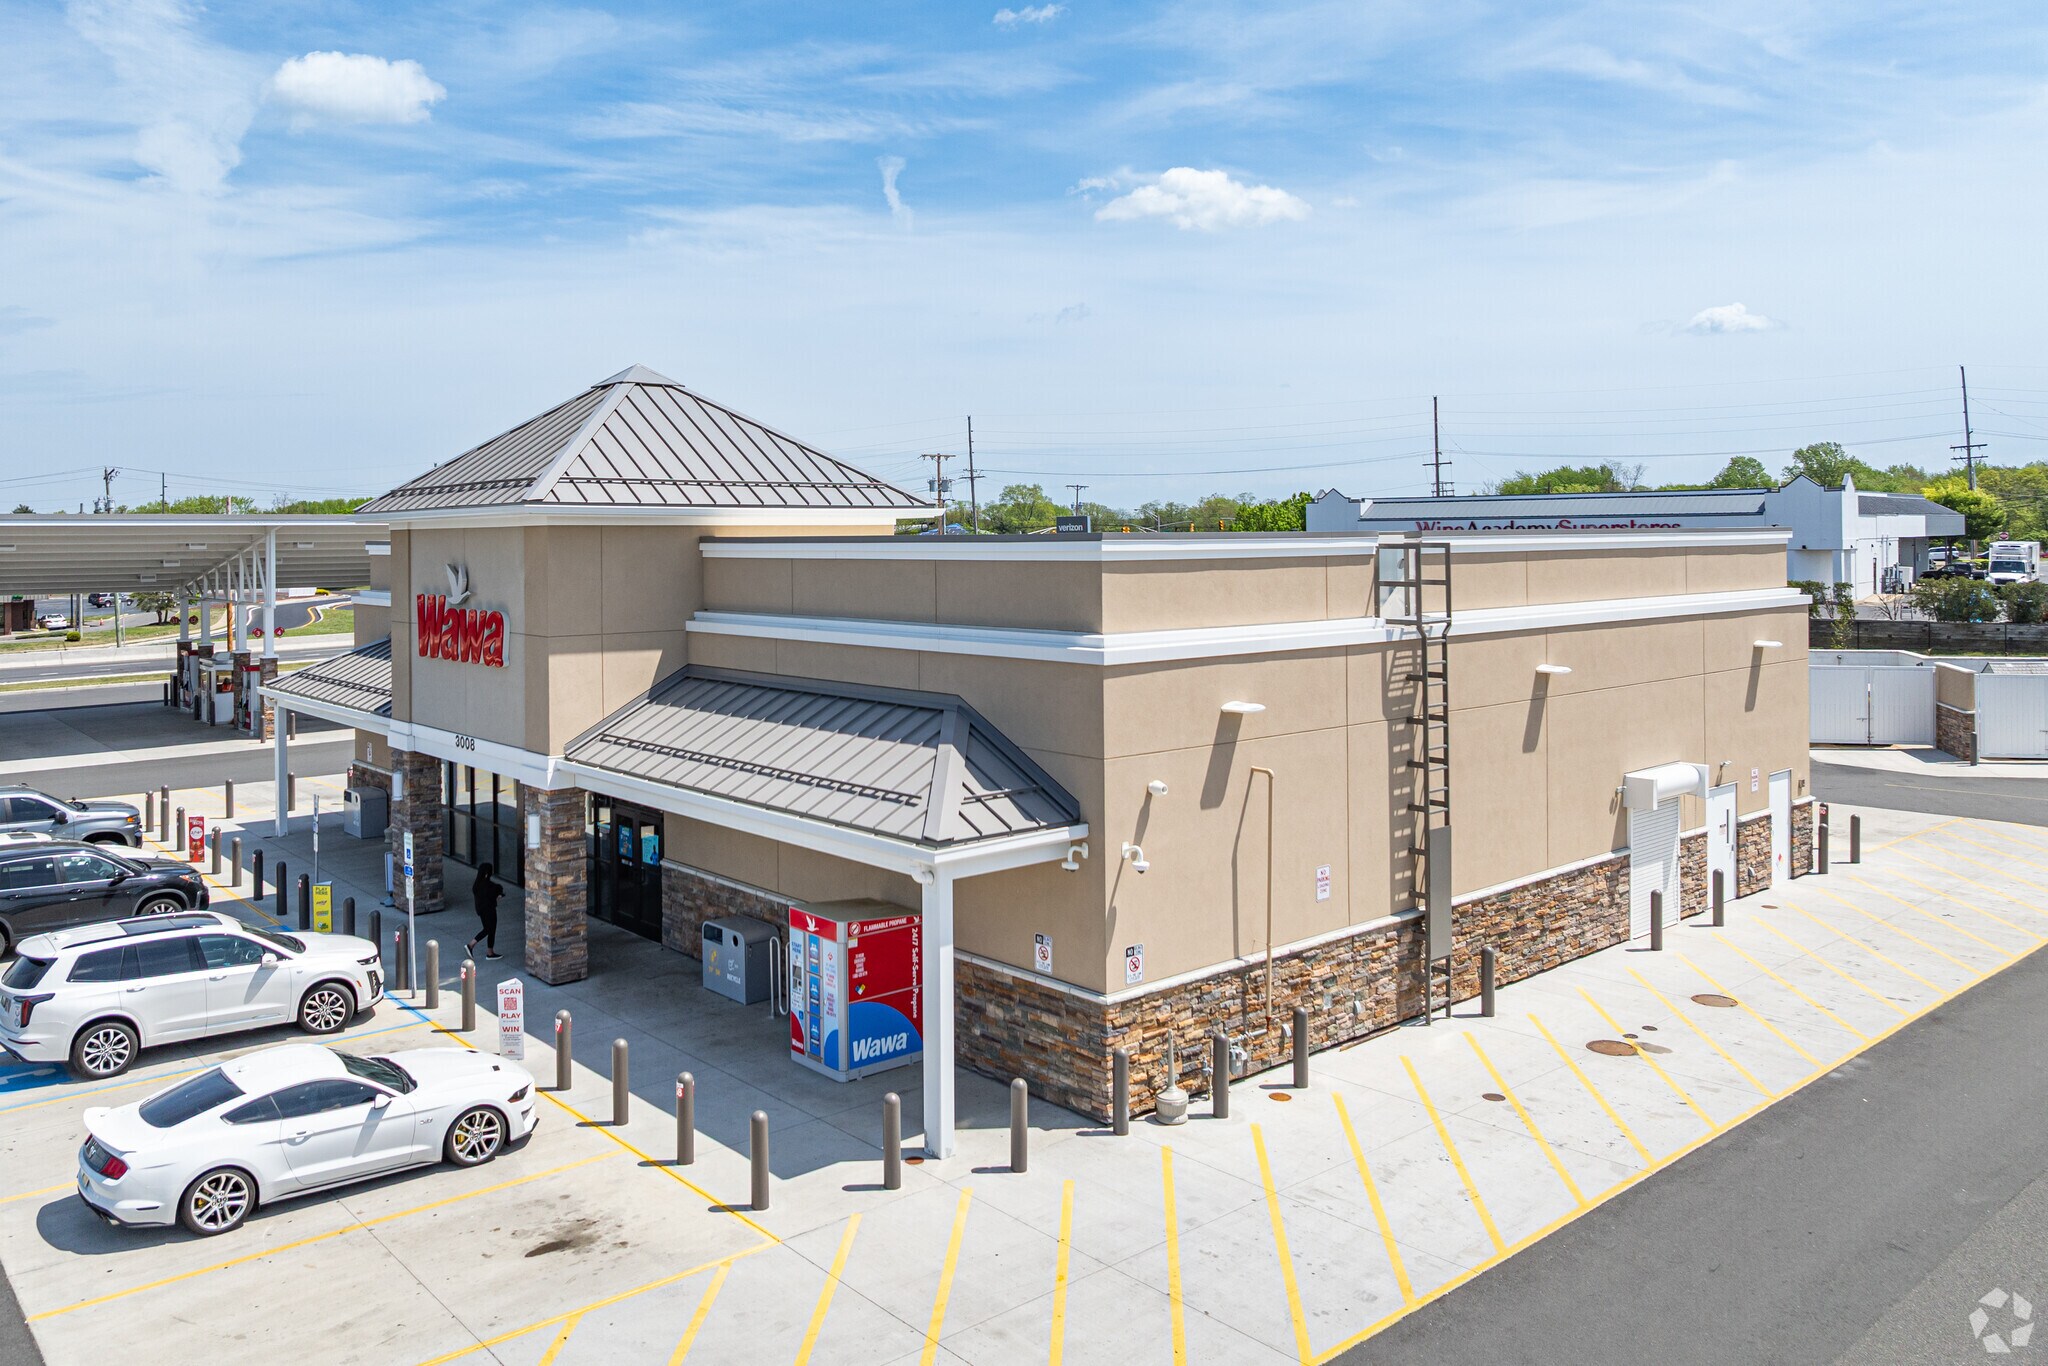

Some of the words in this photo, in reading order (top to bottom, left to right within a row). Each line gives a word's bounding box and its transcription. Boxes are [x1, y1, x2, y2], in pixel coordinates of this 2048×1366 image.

[1058, 523, 1084, 531] verizon
[417, 593, 504, 668] Wawa
[455, 734, 475, 751] 3008
[864, 920, 889, 932] FLAMMABLE
[888, 917, 907, 927] PROPANE
[910, 988, 918, 1018] Propane
[852, 1032, 908, 1062] Wawa
[676, 1088, 682, 1097] 8
